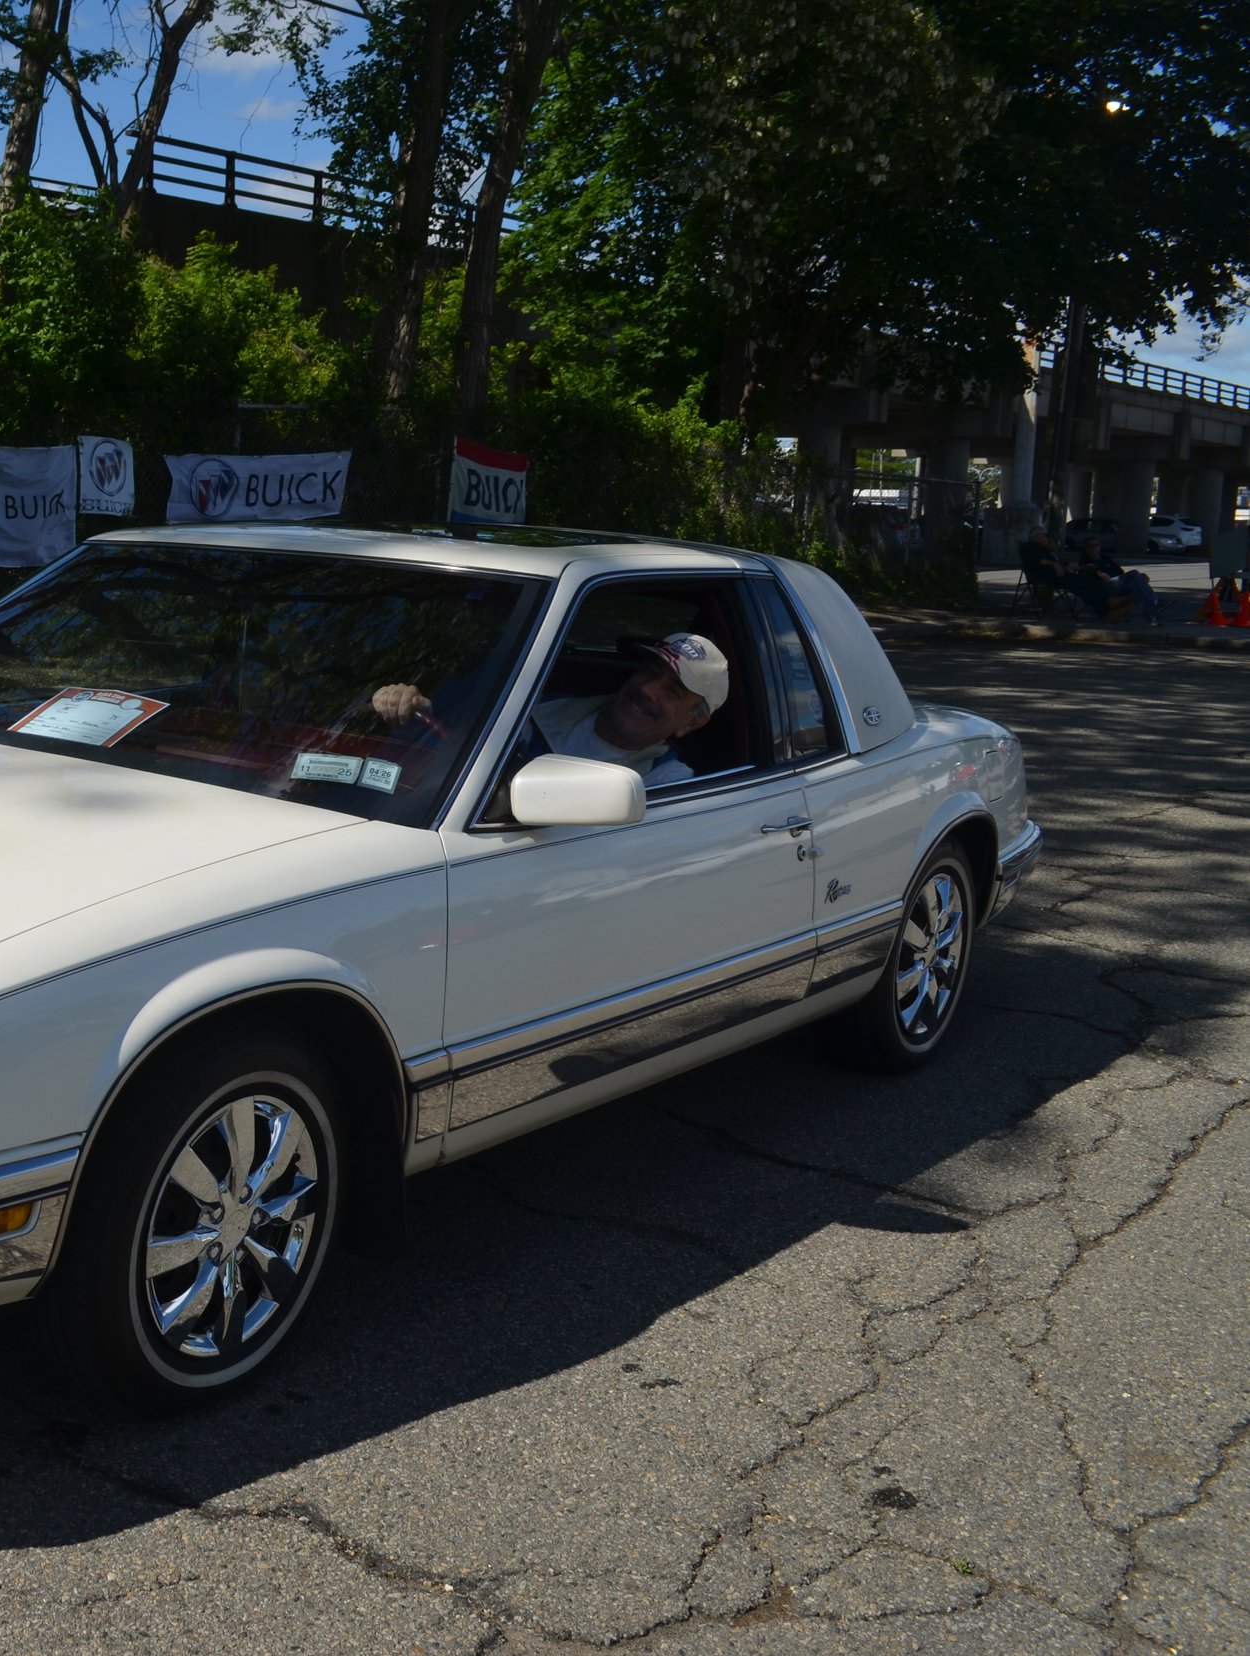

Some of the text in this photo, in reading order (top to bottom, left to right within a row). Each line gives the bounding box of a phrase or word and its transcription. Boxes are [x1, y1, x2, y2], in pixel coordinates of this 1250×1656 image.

[245, 469, 343, 508] BUICK
[81, 498, 133, 514] BUICK
[337, 767, 352, 777] 25
[369, 767, 392, 778] 04 26
